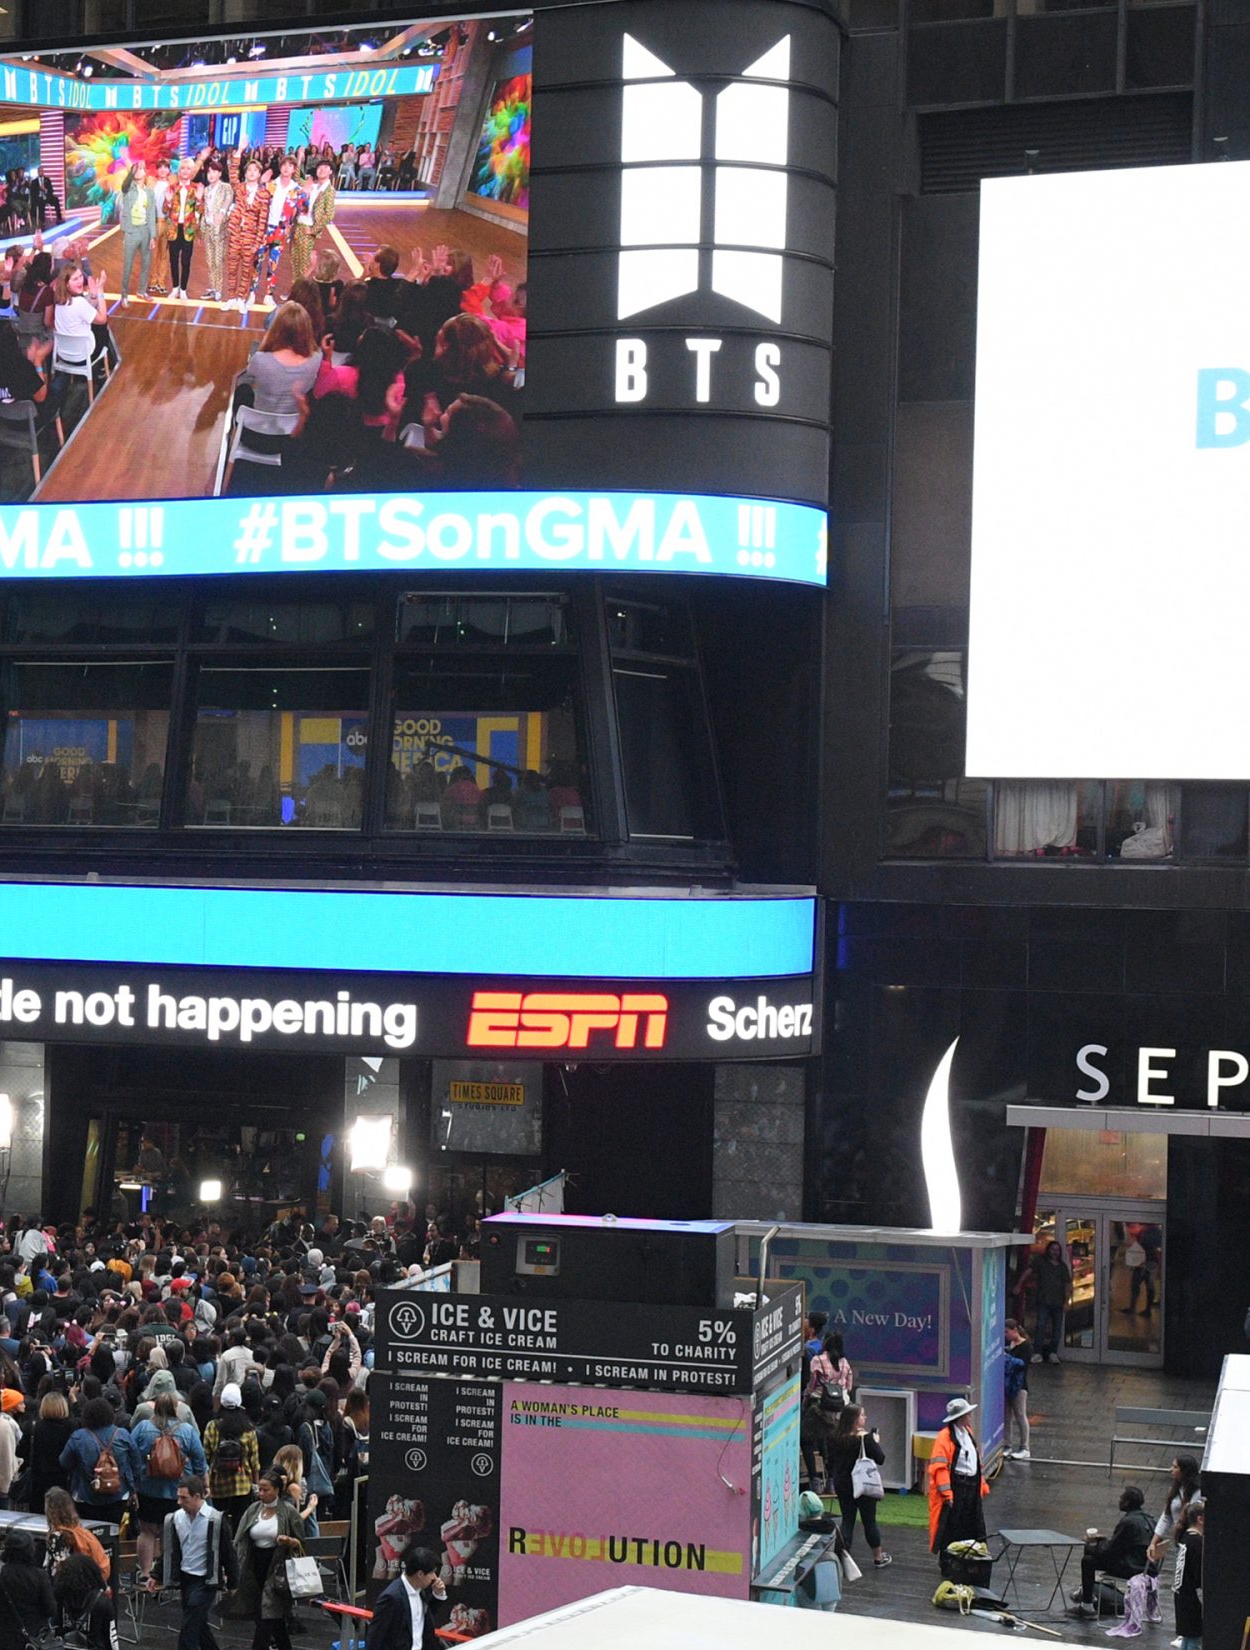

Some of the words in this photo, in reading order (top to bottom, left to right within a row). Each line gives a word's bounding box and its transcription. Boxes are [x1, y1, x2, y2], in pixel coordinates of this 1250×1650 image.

[29, 72, 65, 106] BTS
[132, 85, 178, 106] BTS
[186, 83, 231, 106] IDOL
[276, 74, 336, 100] BTS
[343, 67, 397, 97] IDOL
[615, 338, 781, 406] BTS
[118, 507, 165, 568] !!!
[234, 498, 712, 564] #BTSonGMA
[737, 504, 777, 568] !!!
[55, 984, 135, 1027] not
[148, 984, 418, 1047] happening
[467, 991, 668, 1047] ESPN
[1075, 1044, 1250, 1107] SEP
[453, 1084, 482, 1099] TIMES
[485, 1085, 521, 1102] SQUARE
[432, 1303, 469, 1327] ICE
[478, 1306, 495, 1328] &
[503, 1307, 557, 1333] VICE
[834, 1309, 847, 1323] A
[852, 1309, 890, 1326] New
[894, 1312, 932, 1332] Day!
[430, 1329, 475, 1343] CRAFT
[480, 1332, 502, 1345] ICE
[508, 1334, 557, 1349] CREAM
[698, 1320, 737, 1344] 5%
[652, 1343, 669, 1356] TO
[675, 1344, 737, 1360] CHARITY
[388, 1351, 392, 1362] I
[397, 1351, 448, 1366] SCREAM
[453, 1355, 477, 1368] FOR
[482, 1357, 501, 1369] ICE
[507, 1359, 557, 1373] CREAM!
[586, 1364, 590, 1376] I
[595, 1365, 648, 1379] SCREAM
[654, 1369, 667, 1381] IN
[672, 1370, 736, 1386] PROTEST!
[395, 1382, 428, 1392] SCREAM
[461, 1387, 495, 1397] SCREAM
[390, 1401, 428, 1411] PROTEST!
[456, 1405, 494, 1416] PROTEST!
[486, 1398, 495, 1406] IN
[510, 1400, 518, 1410] A
[522, 1401, 578, 1415] WOMAN'S
[582, 1406, 619, 1418] PLACE
[395, 1414, 428, 1424] SCREAM
[460, 1419, 494, 1429] SCREAM
[510, 1414, 521, 1424] IS
[525, 1414, 536, 1425] IN
[541, 1416, 561, 1427] THE
[381, 1432, 394, 1440] ICE
[396, 1432, 427, 1442] CREAM!
[412, 1424, 427, 1433] FOR
[478, 1430, 494, 1438] FOR
[447, 1437, 460, 1445] ICE
[462, 1437, 494, 1448] CREAM!
